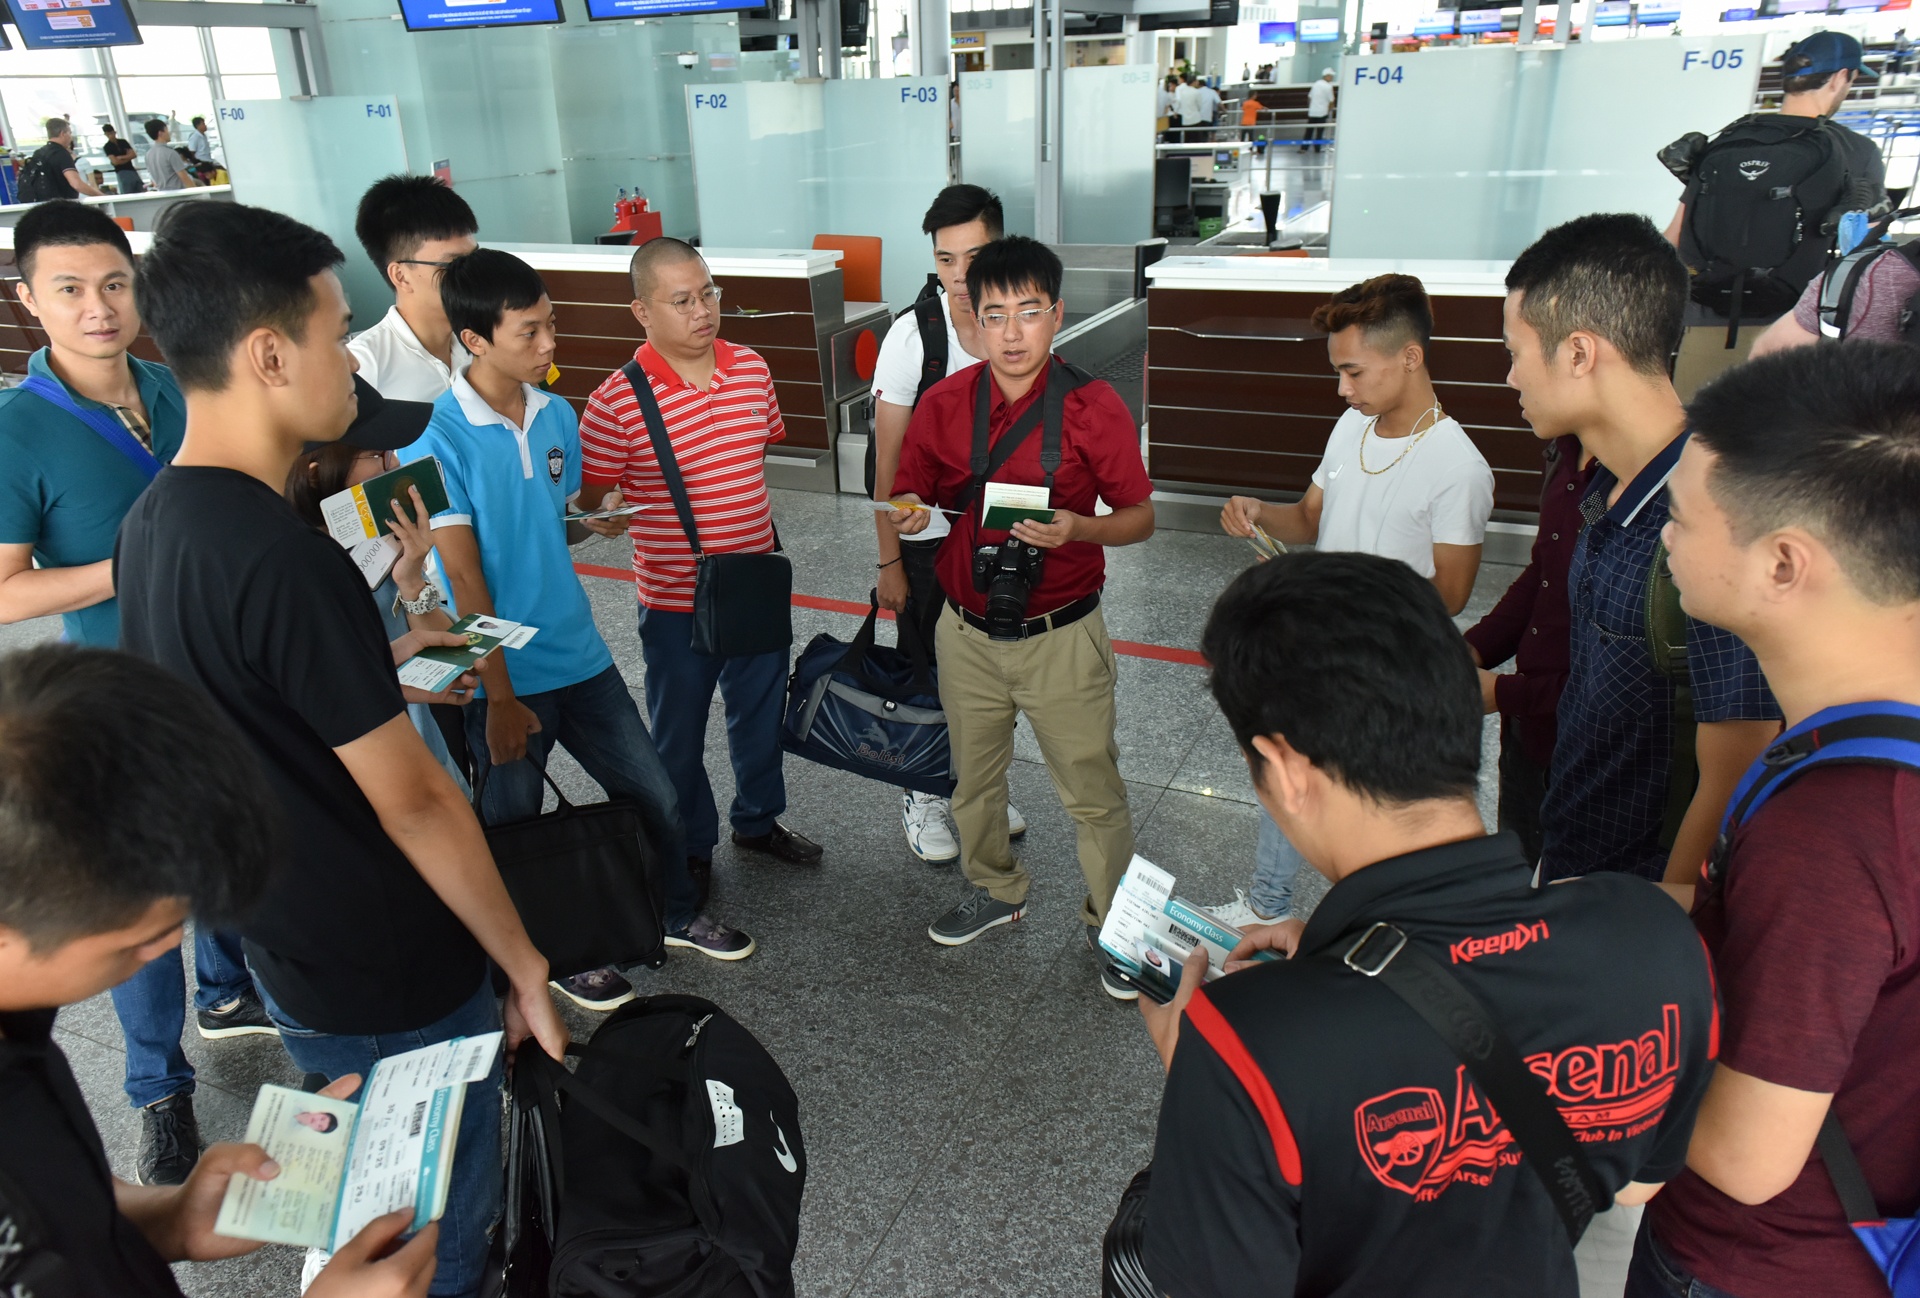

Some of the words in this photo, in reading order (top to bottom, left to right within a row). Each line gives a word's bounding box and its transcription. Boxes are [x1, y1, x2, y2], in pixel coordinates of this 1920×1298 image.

[1682, 49, 1744, 71] F-05
[1354, 65, 1403, 86] F-04
[695, 94, 727, 109] F-02
[901, 86, 938, 103] F-03
[220, 107, 245, 122] F-00
[366, 104, 392, 119] F-01
[856, 742, 906, 765] Bolisi
[1169, 905, 1203, 931] Economy
[1203, 925, 1224, 942] Class
[1449, 919, 1550, 965] KeepDri
[1449, 1004, 1680, 1147] Asenal
[430, 1087, 450, 1128] Economy
[1366, 1100, 1435, 1132] Arsenal
[426, 1127, 441, 1154] Class
